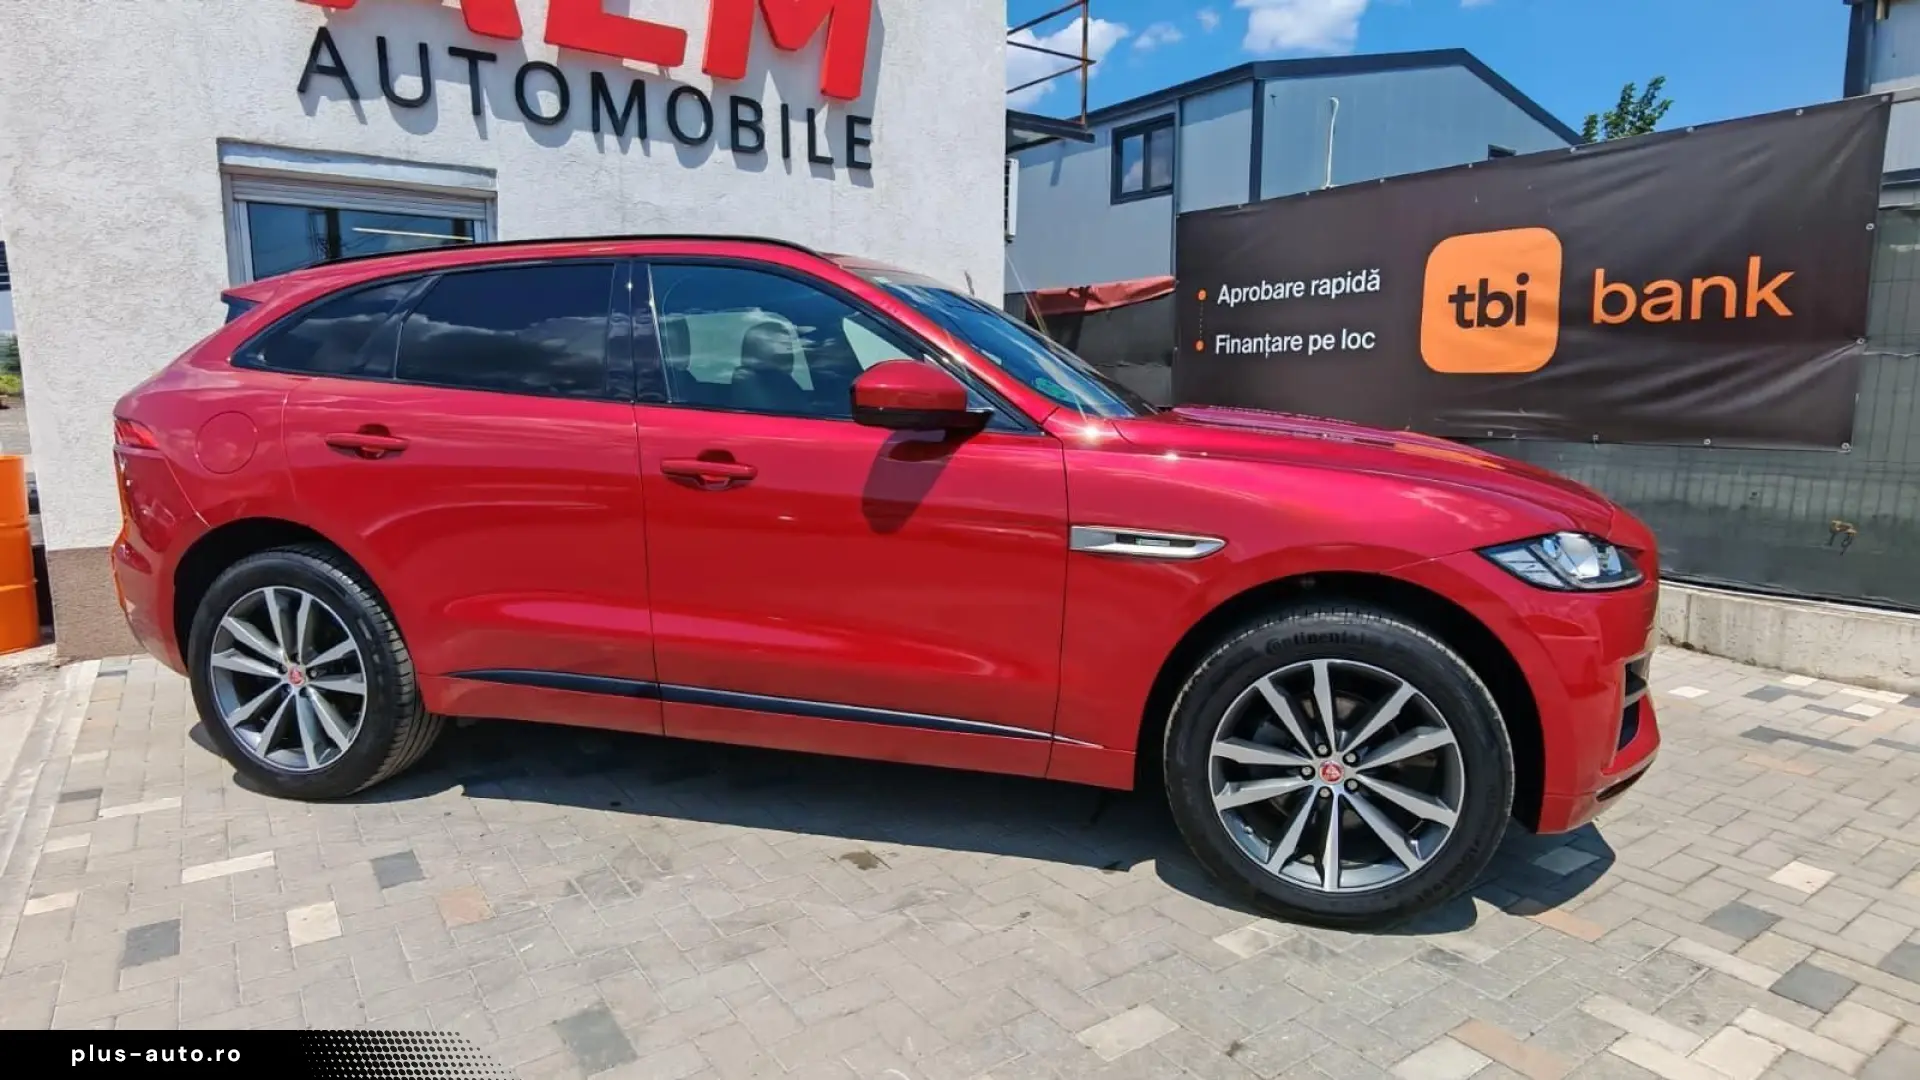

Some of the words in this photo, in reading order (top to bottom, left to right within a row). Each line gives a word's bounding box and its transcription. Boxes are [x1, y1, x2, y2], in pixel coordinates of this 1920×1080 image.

[297, 25, 873, 171] AUTOMOBILE
[1216, 281, 1306, 308] Aprobare
[1310, 268, 1382, 300] rapidă
[1448, 272, 1531, 329] tbi
[1592, 255, 1794, 324] bank
[1214, 332, 1304, 359] Finanțare
[1307, 333, 1336, 356] pe
[1340, 328, 1376, 350] loc
